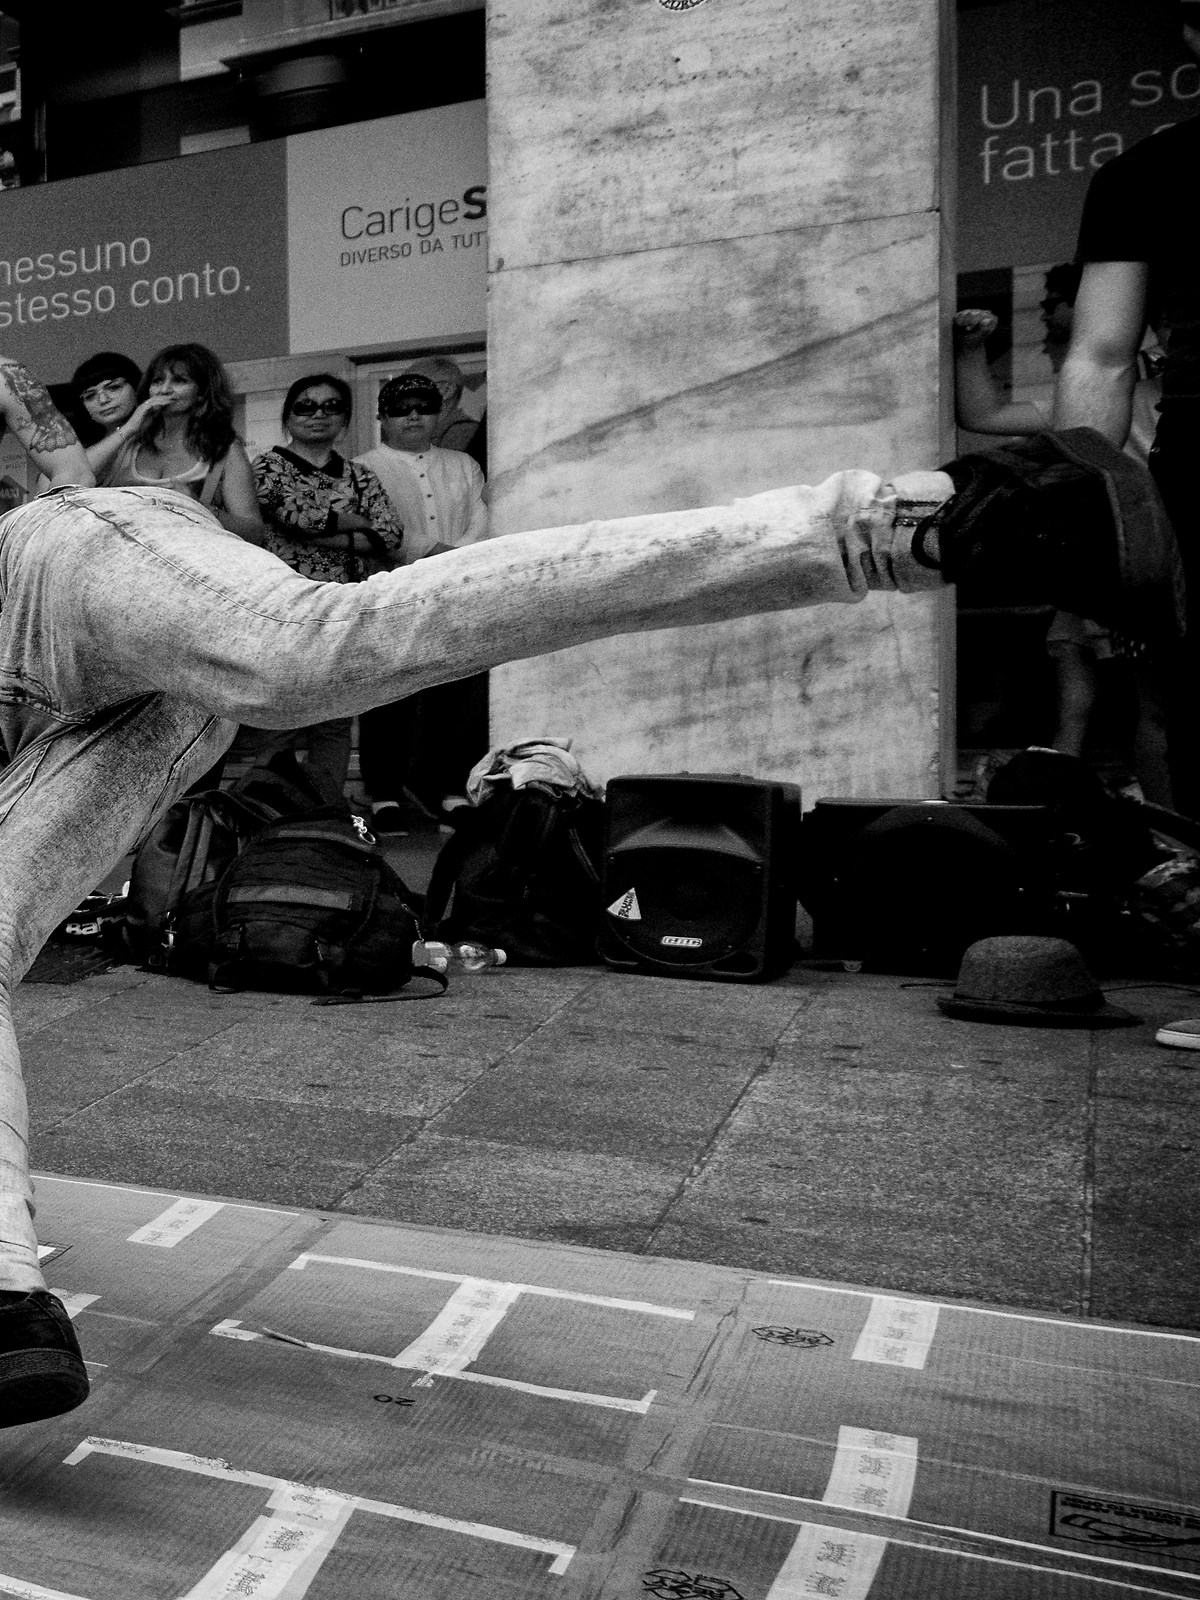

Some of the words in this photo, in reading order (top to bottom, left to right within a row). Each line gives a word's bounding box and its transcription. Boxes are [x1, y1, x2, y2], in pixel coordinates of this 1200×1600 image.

[980, 79, 1101, 129] Una
[979, 130, 1123, 184] fatta
[340, 242, 412, 266] DIVERSO
[420, 238, 444, 255] DA
[130, 262, 251, 307] conto.
